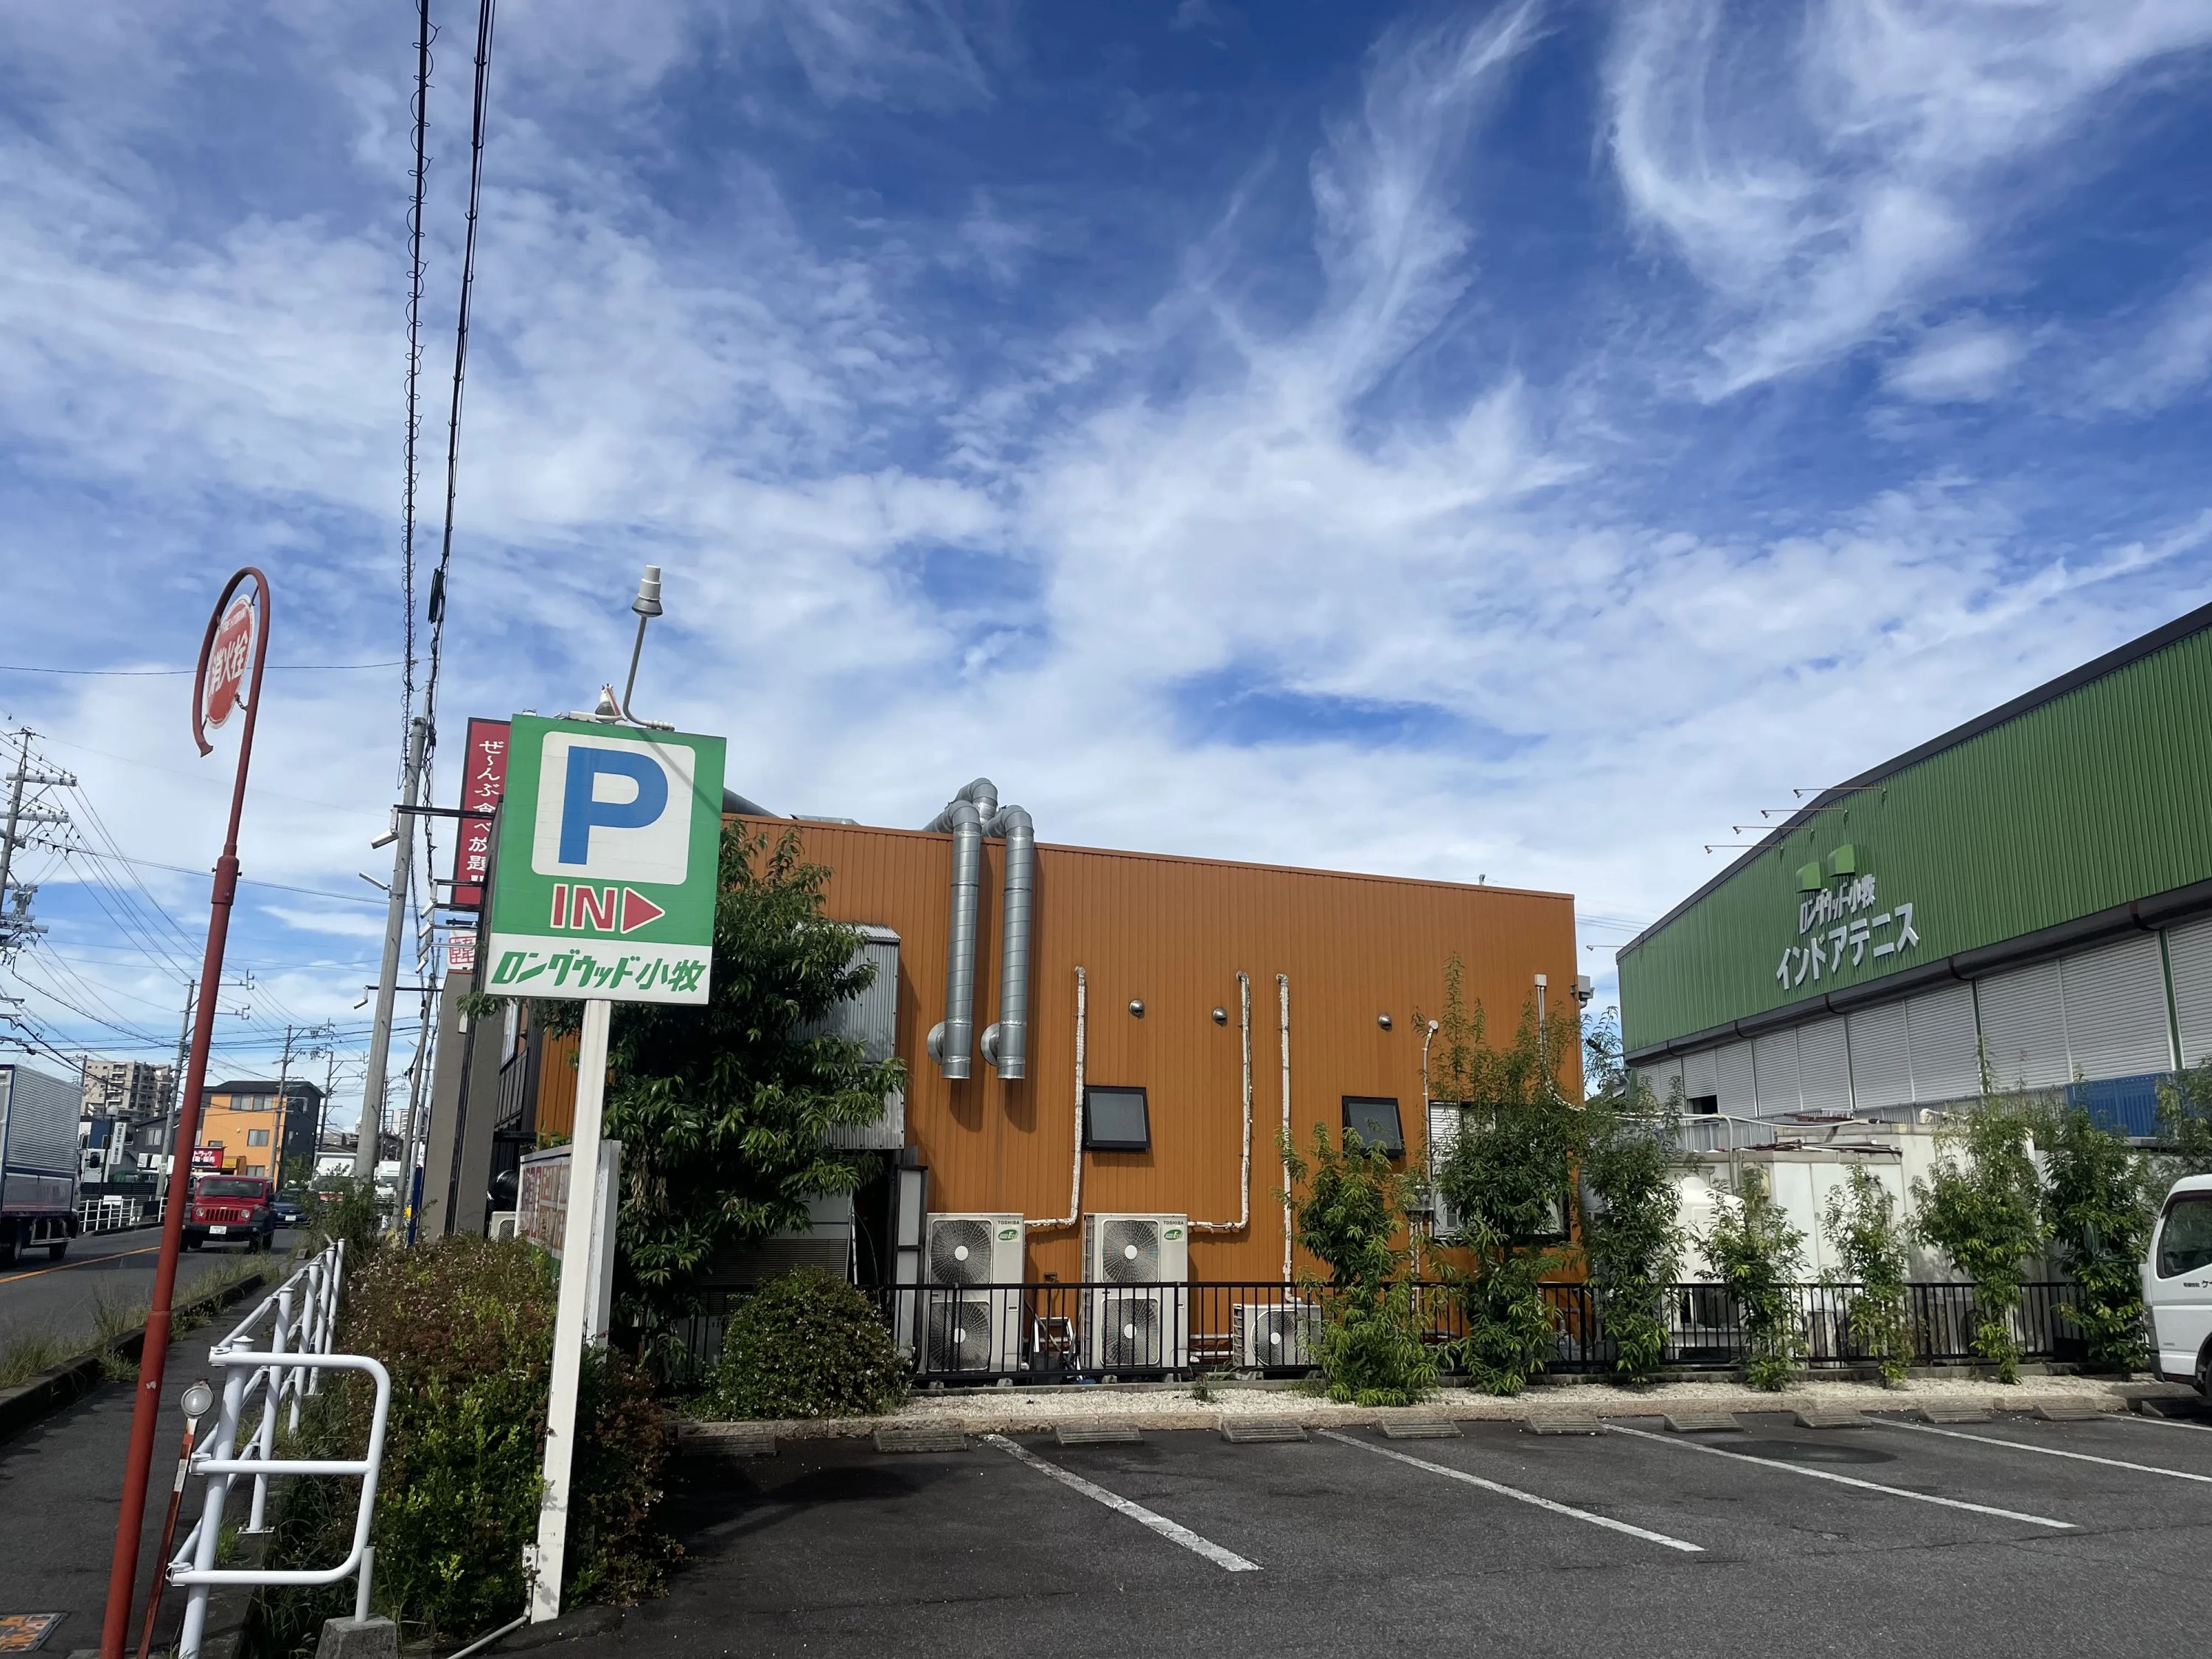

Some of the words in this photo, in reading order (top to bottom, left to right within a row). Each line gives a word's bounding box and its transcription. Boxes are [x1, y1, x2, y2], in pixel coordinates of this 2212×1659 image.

[209, 630, 248, 697] 消火栓
[558, 745, 668, 865] P
[551, 883, 618, 931] IN
[490, 948, 707, 992] ロングウッド小牧
[1775, 902, 1919, 990] インドアテニス
